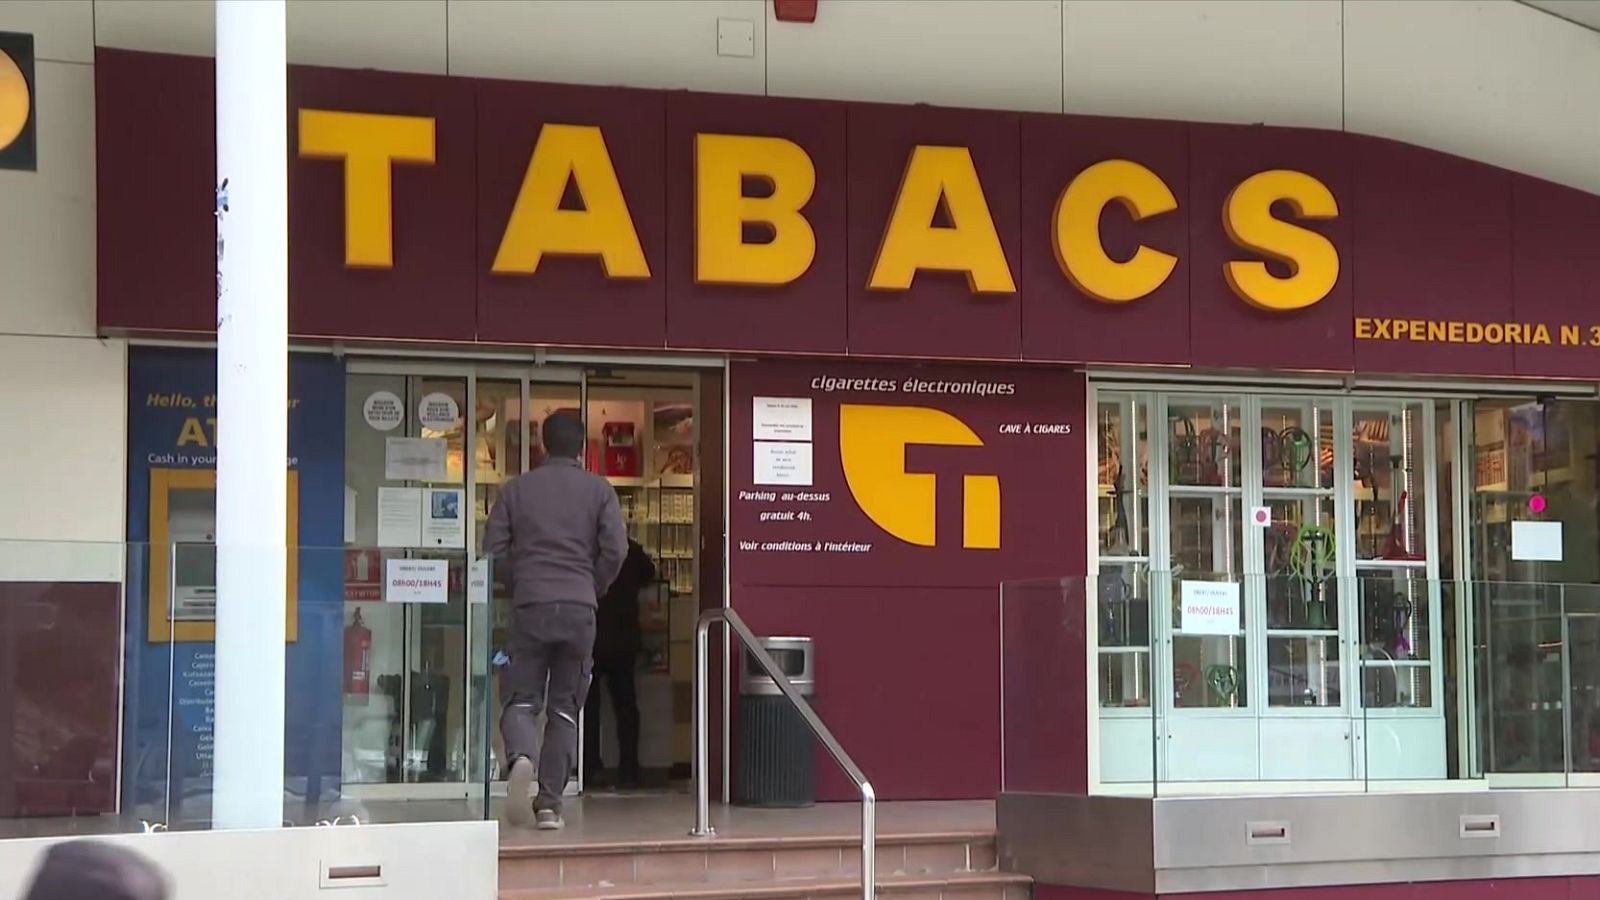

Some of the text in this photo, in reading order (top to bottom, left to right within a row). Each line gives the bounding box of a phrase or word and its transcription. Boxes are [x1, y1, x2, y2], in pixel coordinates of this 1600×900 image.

[298, 109, 1339, 310] TABACS
[1355, 318, 1552, 344] EXPENEDORIA
[811, 375, 1015, 397] cigarettes électroniques
[146, 393, 197, 409] Hello,
[999, 421, 1071, 435] CAVE À CIGARES
[148, 453, 174, 464] Cash
[177, 453, 188, 464] in
[739, 491, 831, 502] Parking au-dessus
[760, 511, 812, 521] gratuit 4h.
[740, 541, 872, 552] Voir conditions à l'intérieur
